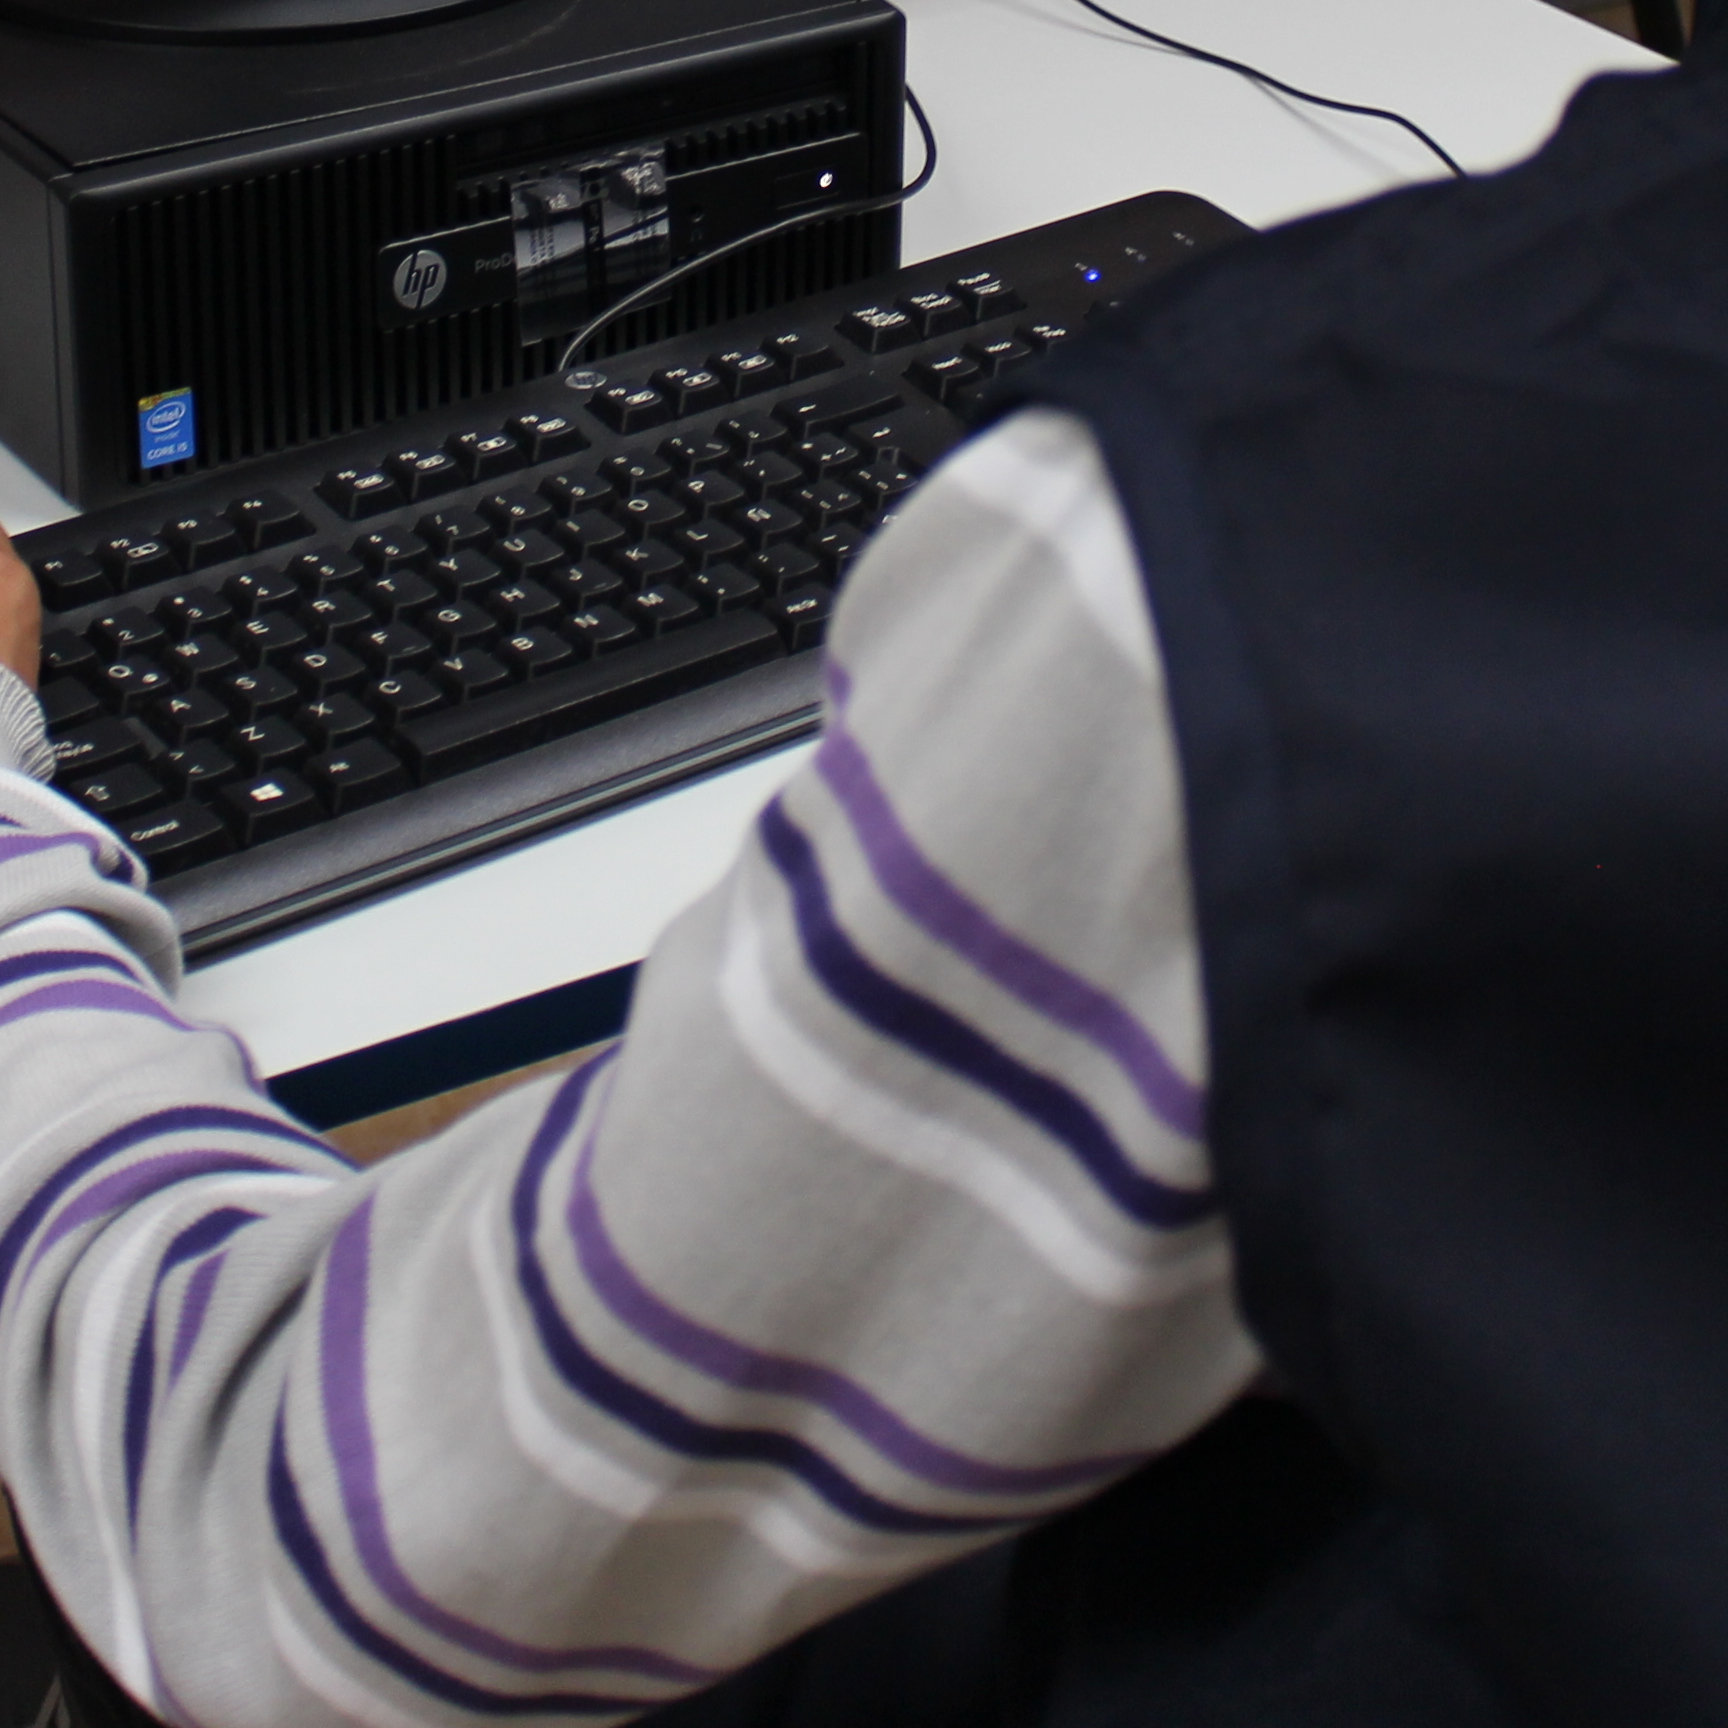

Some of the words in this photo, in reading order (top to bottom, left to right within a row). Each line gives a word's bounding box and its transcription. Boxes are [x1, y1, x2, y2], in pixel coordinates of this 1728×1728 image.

[396, 251, 446, 310] hp
[503, 538, 526, 552] U
[378, 680, 402, 694] C
[240, 726, 265, 742] Z
